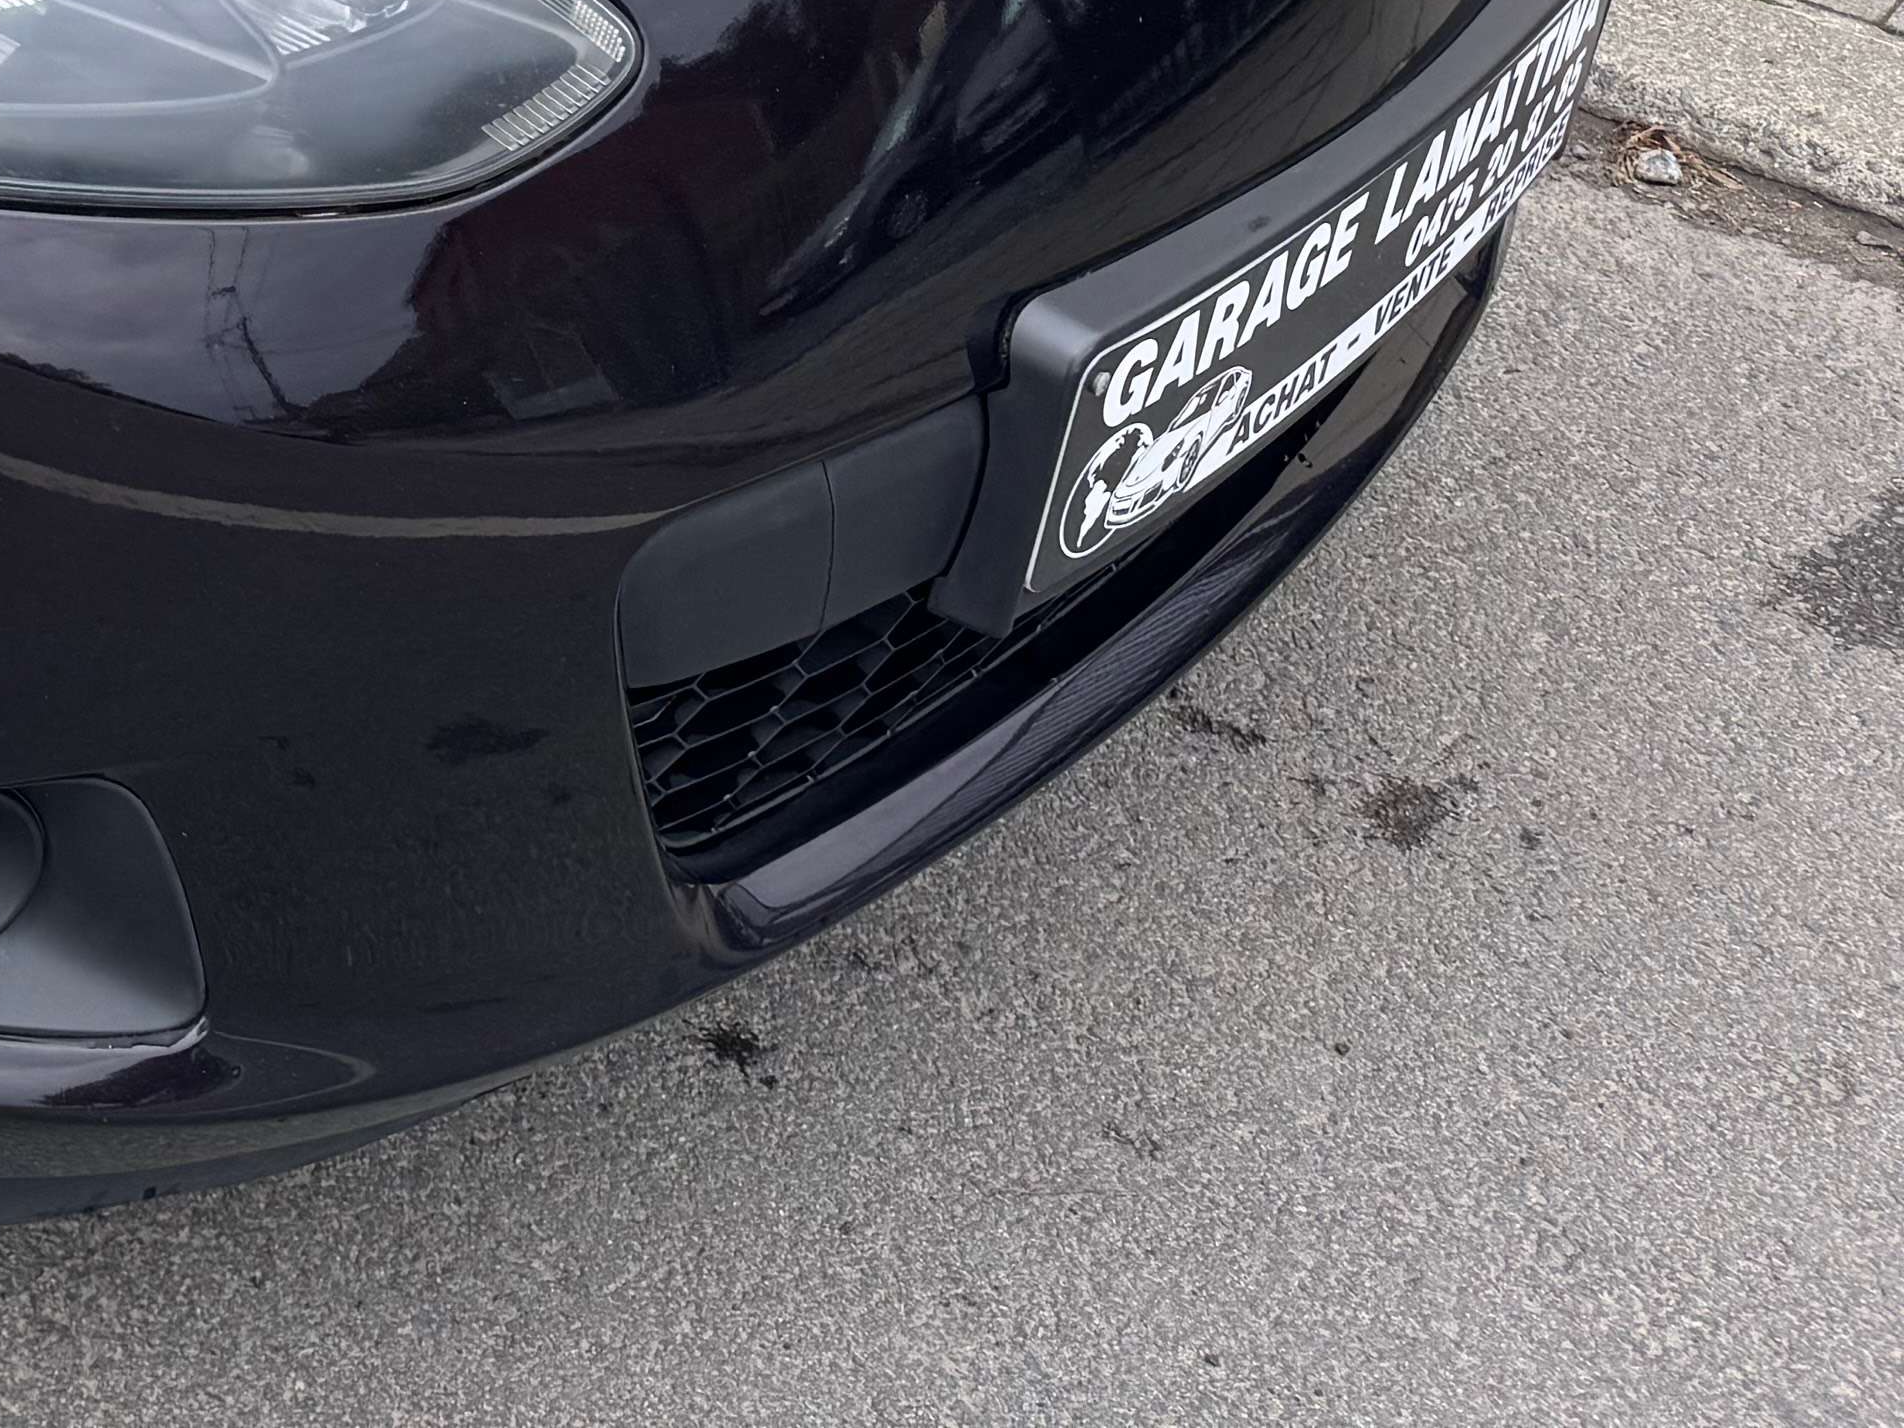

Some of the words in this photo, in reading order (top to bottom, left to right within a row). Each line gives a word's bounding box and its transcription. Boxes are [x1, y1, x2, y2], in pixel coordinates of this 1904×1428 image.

[1405, 167, 1480, 267] 0475
[1479, 128, 1520, 197] 20
[1522, 86, 1557, 153] 87
[1553, 46, 1587, 114] 85
[1103, 191, 1371, 428] GARAGE
[1227, 343, 1338, 457] ACHAT
[1374, 240, 1456, 337] VENTE
[1479, 107, 1571, 232] REPRISE
